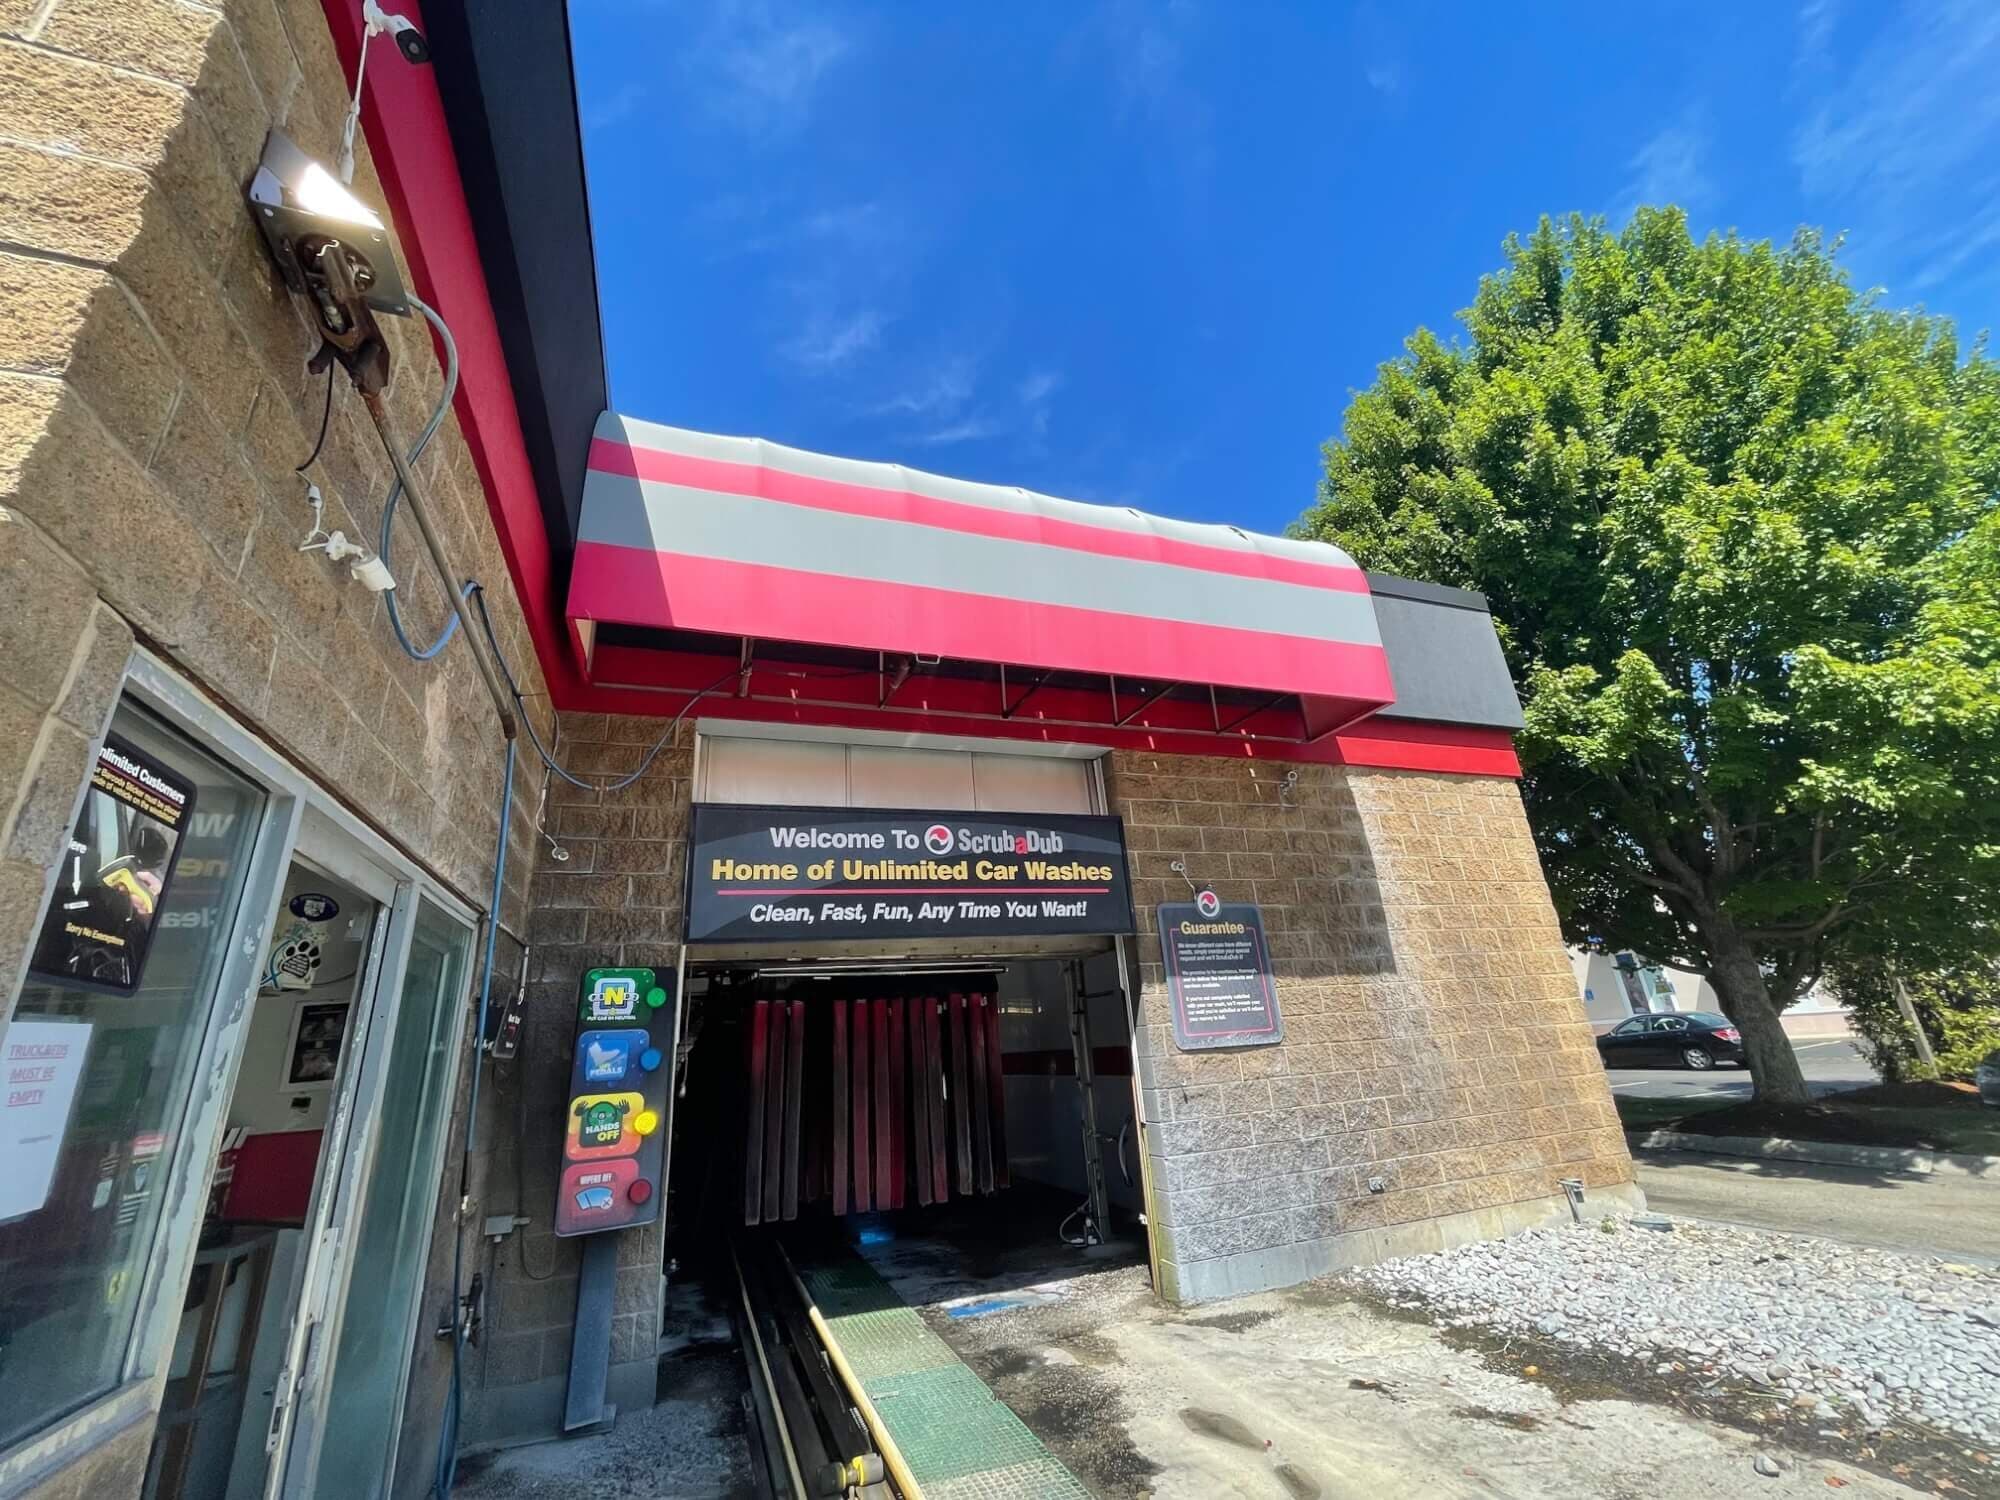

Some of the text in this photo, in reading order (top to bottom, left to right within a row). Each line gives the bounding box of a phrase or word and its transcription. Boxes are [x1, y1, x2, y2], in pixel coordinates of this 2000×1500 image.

[99, 747, 185, 804] nlimited Customers
[769, 827, 1064, 854] Welcome To ScrubaDub
[711, 859, 1113, 881] Home of Unlimited Car Washes
[750, 901, 1087, 925] Clean, Fast, Fun, Any Time You Want!
[1180, 921, 1245, 935] Guarantee
[604, 986, 625, 1006] N
[590, 1066, 624, 1076] PEDALS
[585, 1121, 620, 1134] HANDS
[597, 1130, 620, 1142] OFF
